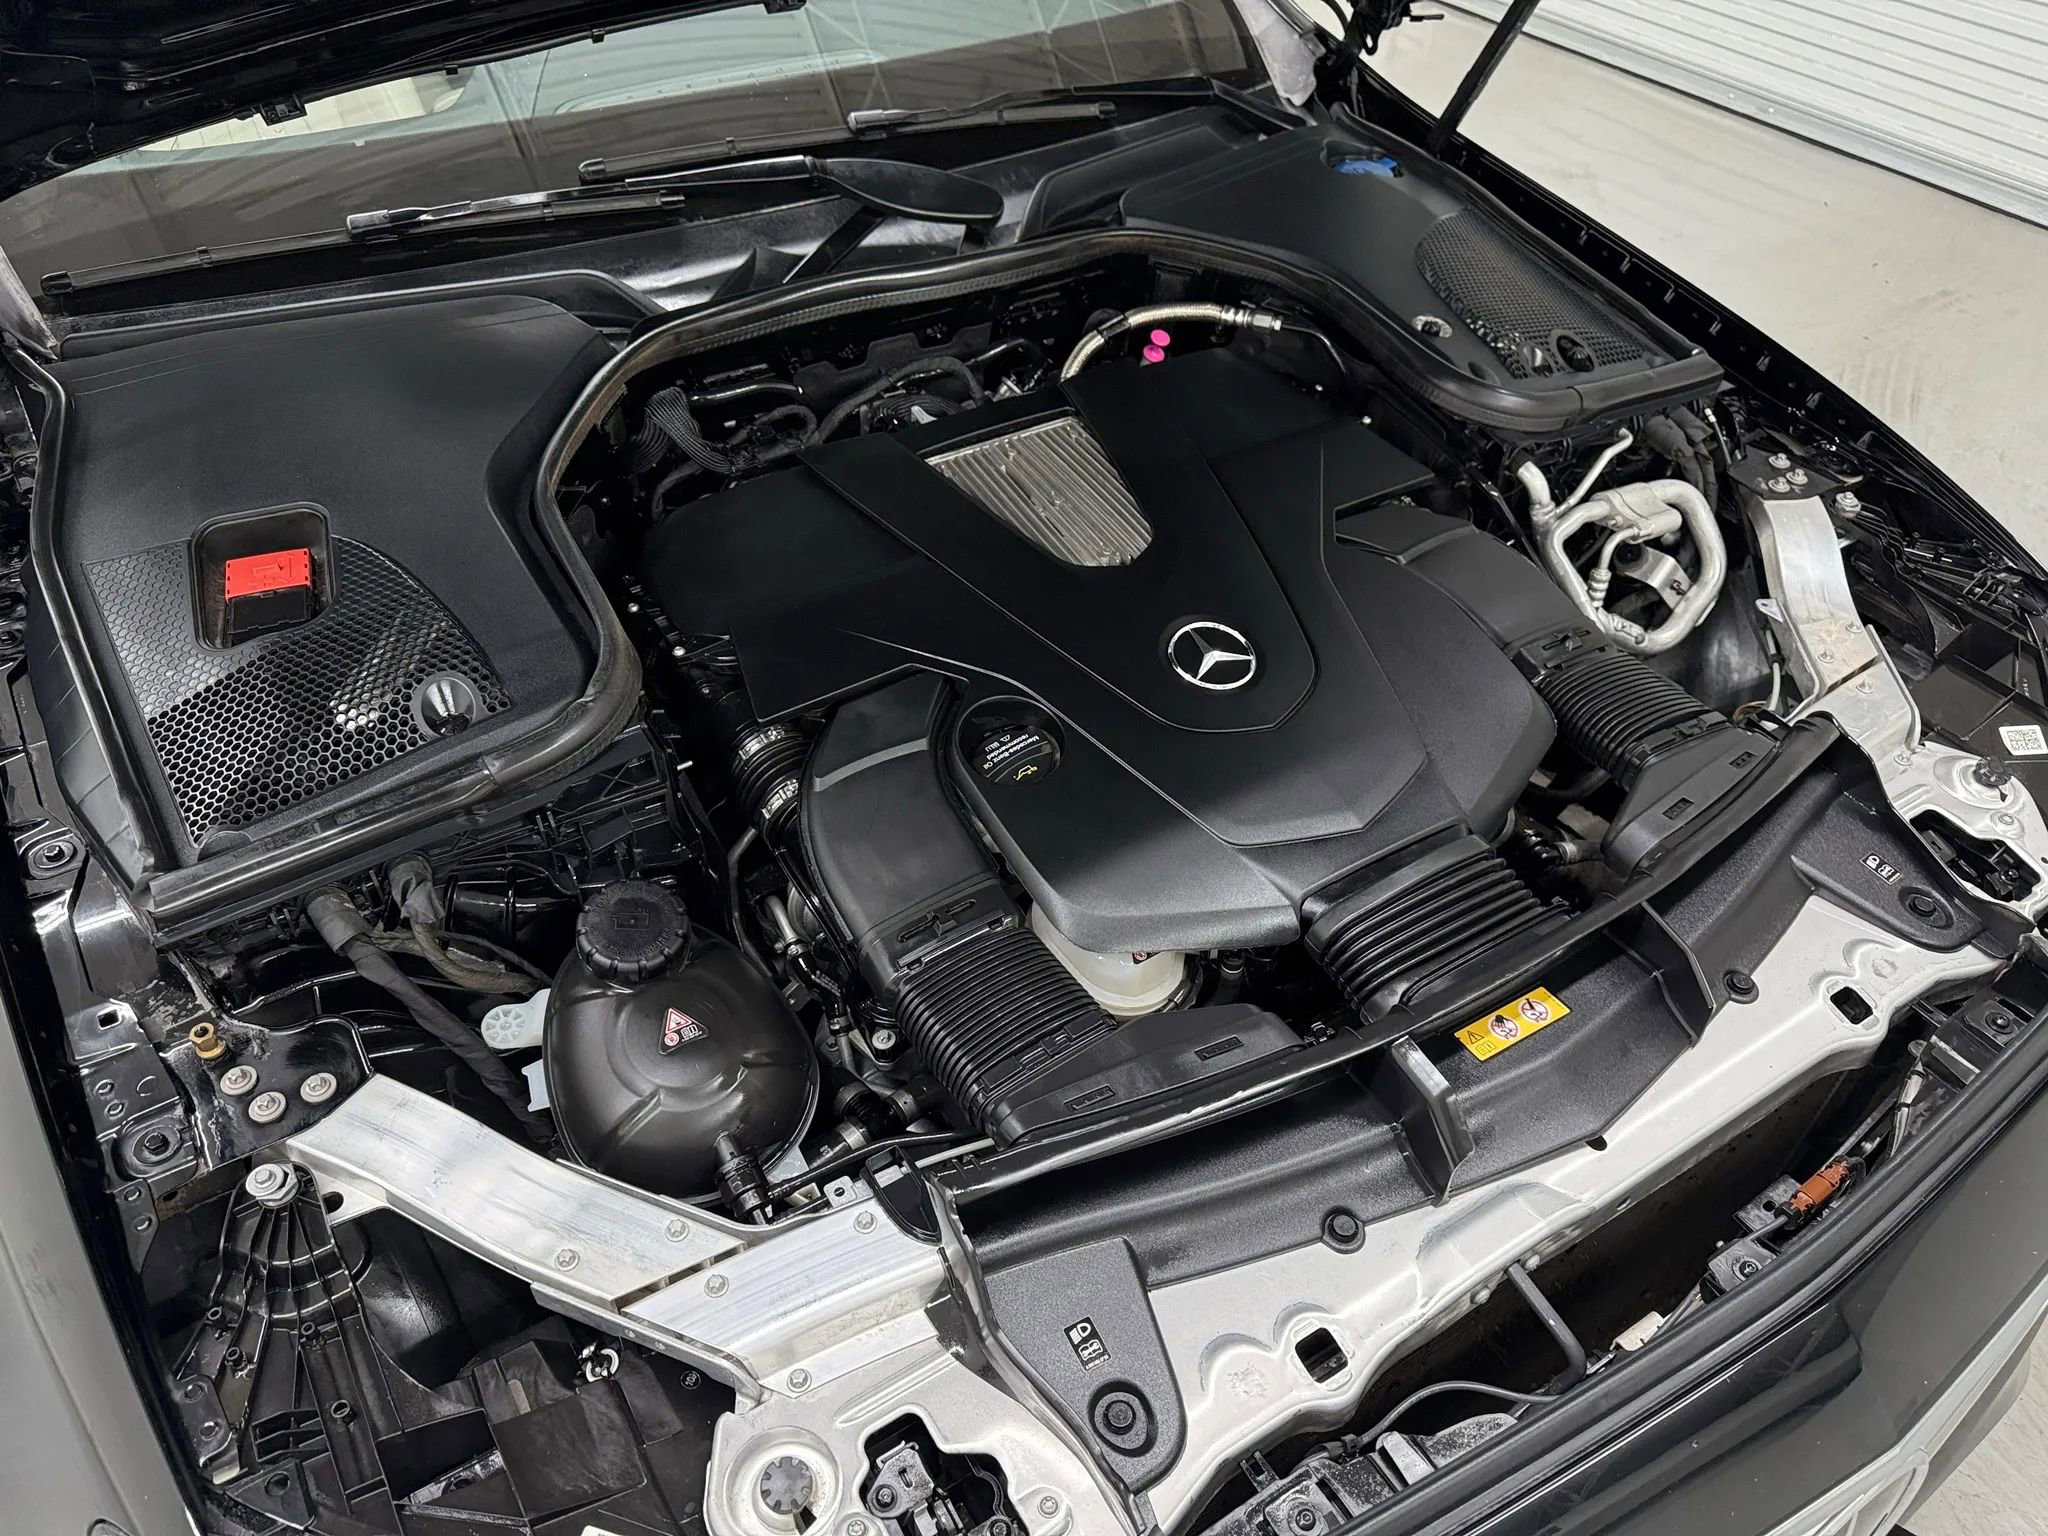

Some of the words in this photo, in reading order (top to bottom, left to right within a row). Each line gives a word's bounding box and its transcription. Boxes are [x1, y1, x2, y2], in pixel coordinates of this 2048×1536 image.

[986, 733, 1029, 761] recommended
[992, 735, 1040, 763] Mercedes-Benz
[982, 761, 993, 770] Oil
